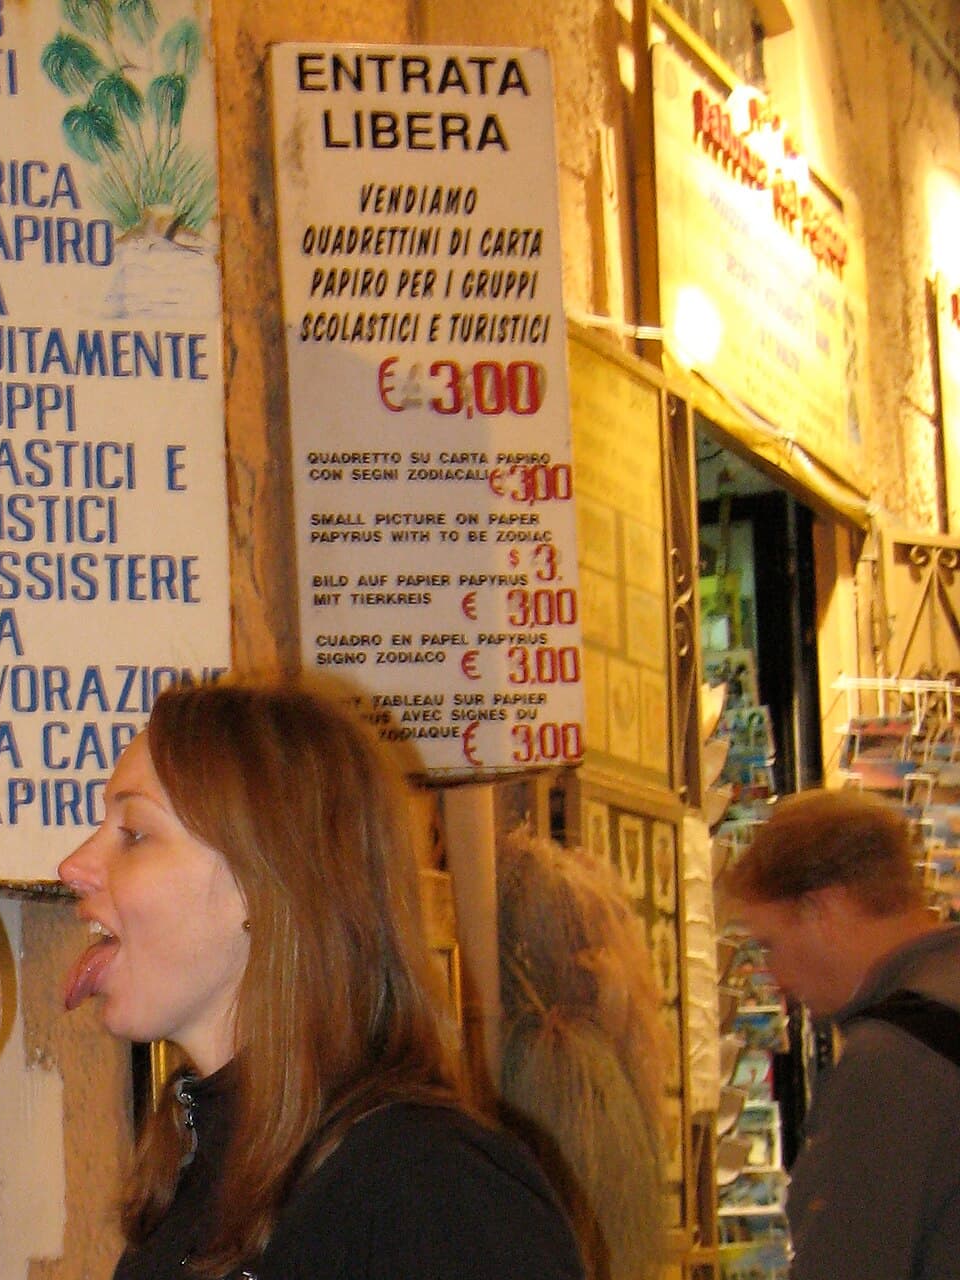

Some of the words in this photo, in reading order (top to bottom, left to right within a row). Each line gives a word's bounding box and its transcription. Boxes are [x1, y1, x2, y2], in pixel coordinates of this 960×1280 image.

[296, 53, 532, 97] ENTRATA
[323, 109, 511, 151] LIBERA
[358, 183, 479, 216] VENDIAMO
[300, 224, 441, 257] QUADRETTINI
[447, 226, 474, 257] DI
[480, 226, 544, 258] CARTA
[309, 267, 389, 298] PAPIRO
[396, 269, 438, 298] PER
[443, 270, 453, 299] I
[461, 269, 539, 299] GRUPPI
[300, 312, 422, 343] SCOLASTICI
[427, 313, 442, 344] E
[447, 313, 552, 344] TURISTICI
[377, 355, 405, 413] €
[166, 444, 188, 492] E
[307, 451, 402, 465] QUADRETTO
[410, 451, 431, 465] SU
[439, 451, 489, 465] CARTA
[496, 451, 551, 465] PAPIRO
[309, 467, 343, 481] CON
[351, 467, 399, 481] SEGNI
[311, 512, 367, 526] SMALL
[375, 512, 447, 526] PICTURE
[455, 512, 479, 526] ON
[488, 512, 540, 526] PAPER
[310, 529, 383, 543] PAPYRUS
[390, 529, 431, 543] WITH
[439, 530, 459, 543] TO
[467, 530, 488, 543] BE
[496, 529, 553, 543] ZODIAC
[312, 574, 349, 588] BILD
[357, 574, 388, 588] AUF
[396, 573, 451, 588] PAPIER
[458, 572, 529, 587] PAPYRUS
[312, 592, 342, 607] MIT
[350, 591, 433, 606] TIERKREIS
[461, 590, 478, 621] €
[316, 634, 383, 647] CUADRO
[391, 634, 413, 647] EN
[420, 633, 470, 647] PAPEL
[477, 632, 549, 646] PAPYRUS
[316, 652, 368, 665] SIGNO
[376, 650, 447, 664] ZODIACO
[461, 649, 482, 681] €
[373, 694, 445, 707] TABLEAU
[453, 693, 485, 706] SUR
[493, 692, 548, 706] PAPIER
[400, 709, 443, 722] AVEC
[450, 708, 508, 722] SIGNES
[517, 708, 538, 721] DU
[42, 721, 149, 771] CAR
[462, 720, 484, 766] €
